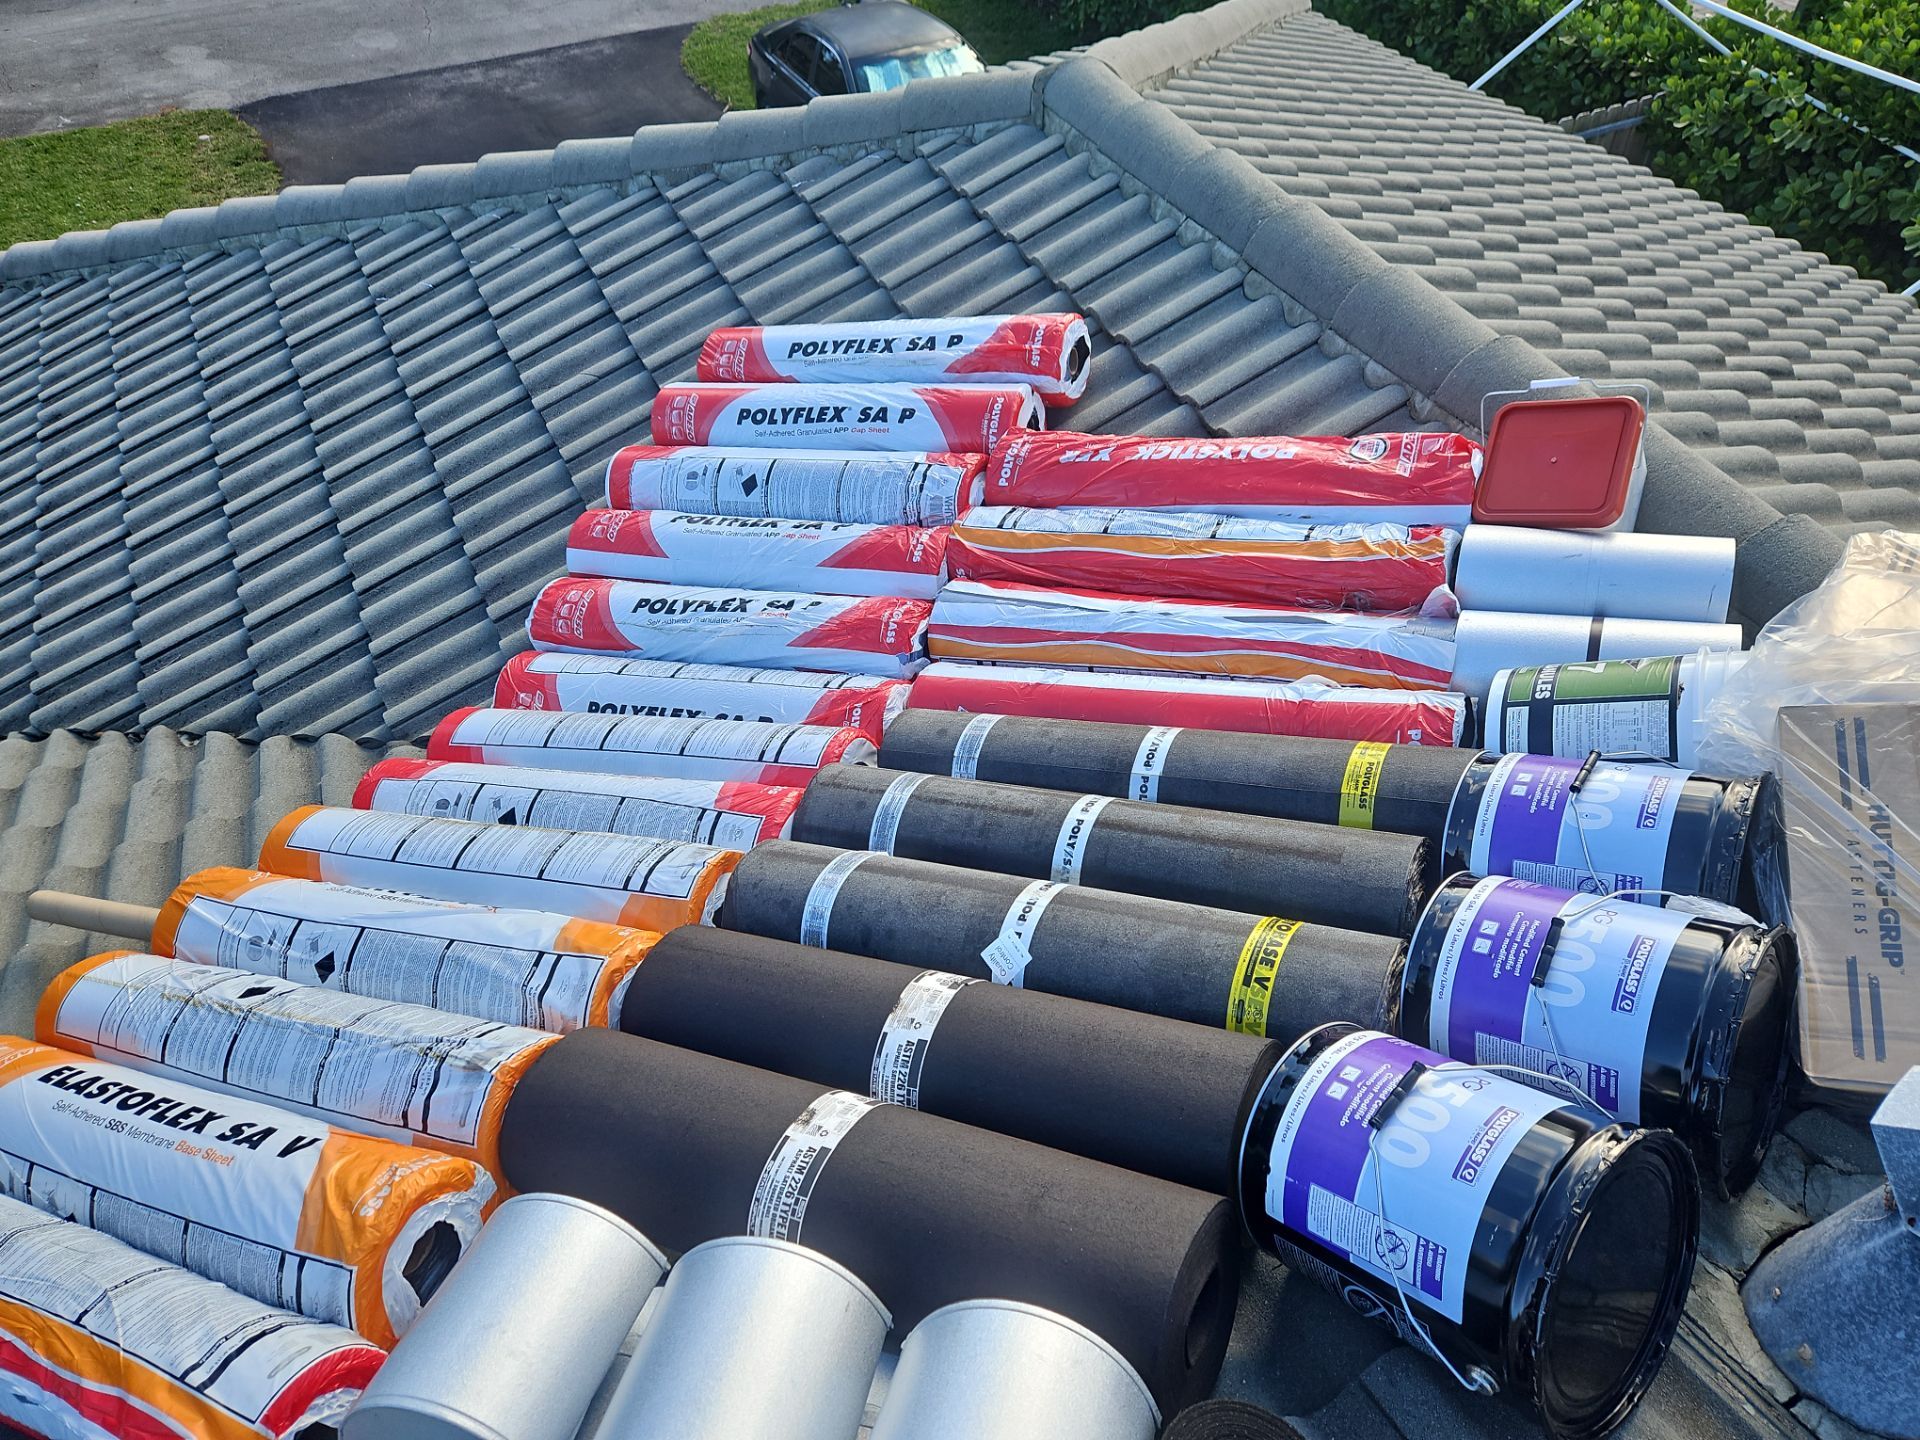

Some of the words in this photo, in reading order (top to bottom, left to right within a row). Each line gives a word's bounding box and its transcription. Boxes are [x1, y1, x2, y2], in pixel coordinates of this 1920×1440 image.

[787, 337, 897, 358] POLYFLEX
[904, 335, 937, 352] SA
[946, 334, 965, 350] P
[737, 406, 848, 425] POLYFLEX
[859, 406, 889, 424] SA
[898, 407, 916, 424] P
[754, 428, 796, 437] Self-Adhered
[867, 427, 891, 435] Sheet
[1131, 444, 1299, 460] POLYSTICK
[631, 597, 754, 615] POLYFLEX
[1359, 762, 1375, 810] POLYGLASS
[1845, 827, 1868, 935] FASTENERS
[1870, 803, 1905, 971] HUTTIG-GRIP
[1507, 911, 1524, 937] Cemento
[1594, 908, 1618, 924] PG
[1515, 920, 1530, 941] Ciment
[1523, 920, 1541, 948] Modified
[988, 952, 1007, 977] Quality
[994, 945, 1014, 970] Control
[1439, 933, 1461, 1000] Liters/Litres/Litros
[1493, 937, 1510, 979] modificado
[1505, 942, 1518, 970] modifié
[1514, 949, 1528, 977] Cement
[1541, 920, 1609, 1008] 500
[1625, 937, 1656, 994] POLYGLASS
[899, 1040, 916, 1069] ASTM
[1317, 1060, 1330, 1075] 17.9
[897, 1070, 908, 1091] 226
[1365, 1063, 1392, 1086] Cemento
[1374, 1072, 1394, 1094] Ciment
[38, 1065, 227, 1135] ELASTOFLEX
[215, 1121, 279, 1150] SA
[276, 1136, 323, 1158] V
[1281, 1072, 1319, 1144] Liters/Litres/Litros
[1340, 1086, 1367, 1127] modificado
[1354, 1093, 1375, 1120] modifié
[1361, 1100, 1383, 1128] Cement
[52, 1099, 105, 1127] Self-Adhered
[104, 1118, 128, 1134] SBS
[125, 1126, 175, 1150] Membrane
[174, 1139, 201, 1155] Base
[201, 1148, 236, 1167] Sheet
[1376, 1074, 1475, 1169] 500
[1471, 1110, 1519, 1164] POLYGLASS
[786, 1149, 804, 1174] ASPHALT
[796, 1146, 817, 1176] ASTM
[773, 1174, 790, 1213] SATURATED
[785, 1175, 801, 1199] 226
[776, 1201, 792, 1231] TYPE
